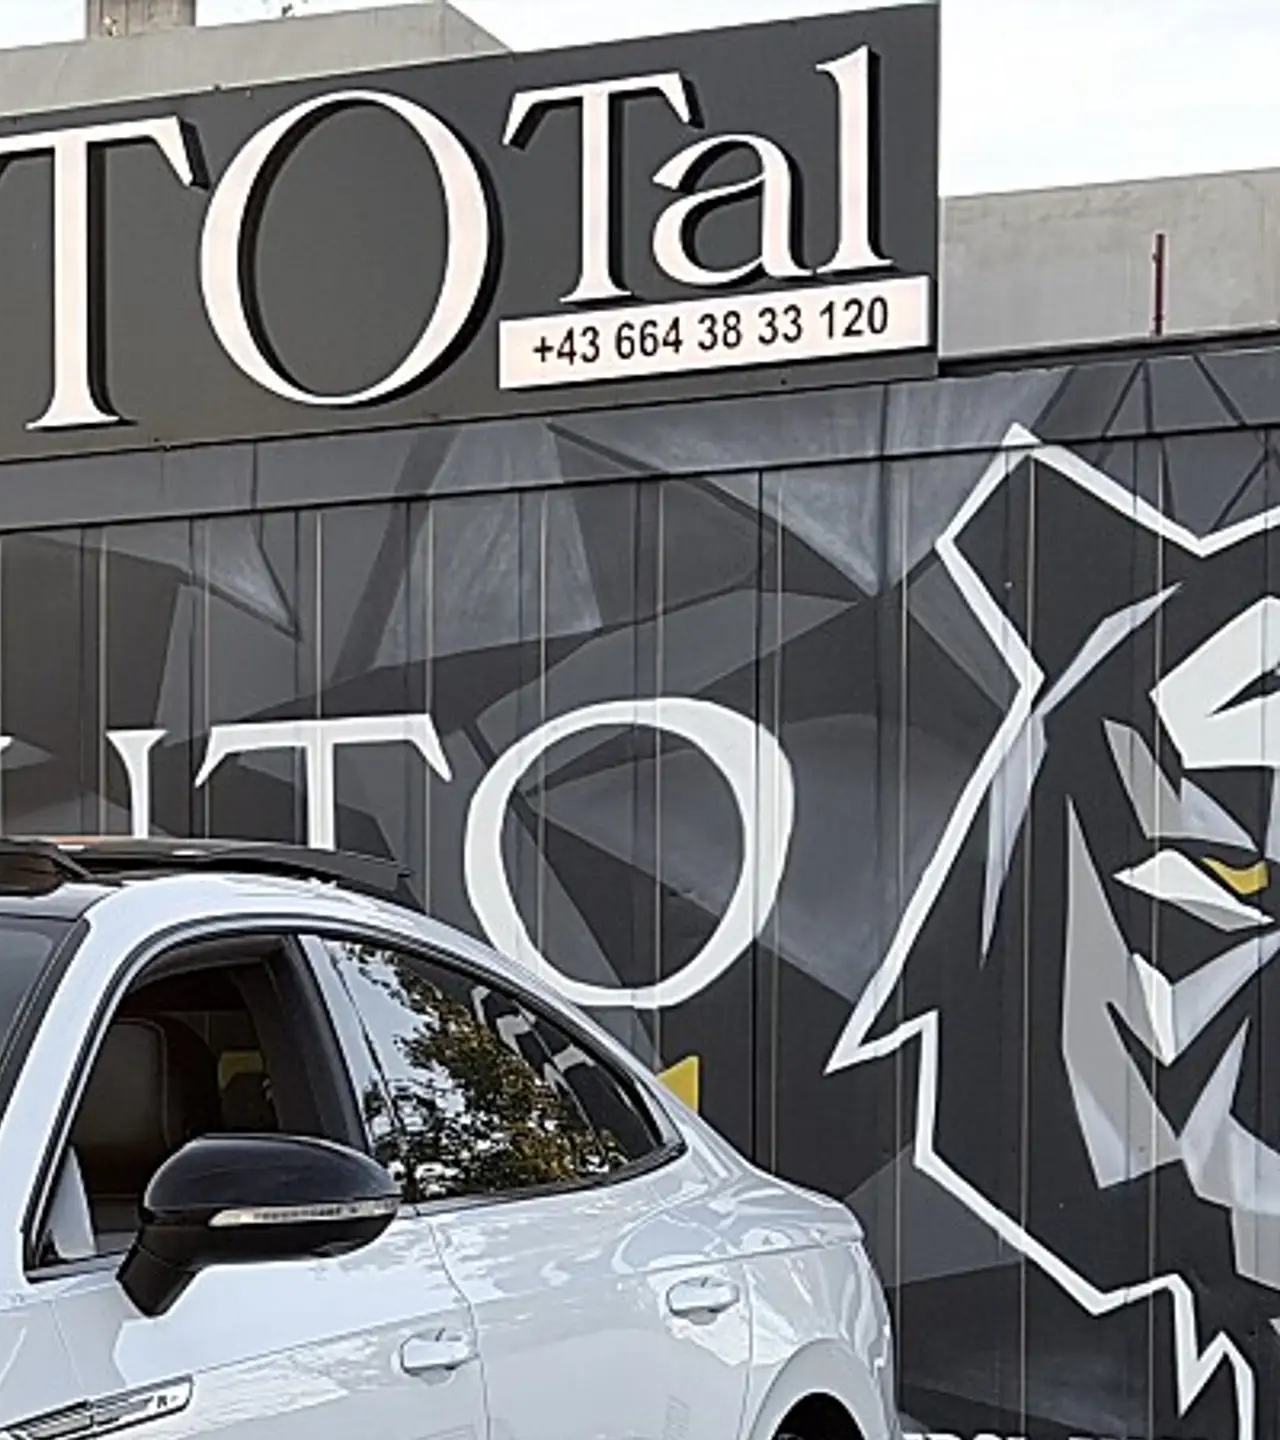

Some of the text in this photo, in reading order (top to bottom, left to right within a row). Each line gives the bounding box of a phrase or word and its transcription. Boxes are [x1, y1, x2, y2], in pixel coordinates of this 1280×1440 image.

[532, 296, 889, 366] +43 664 38 33 120
